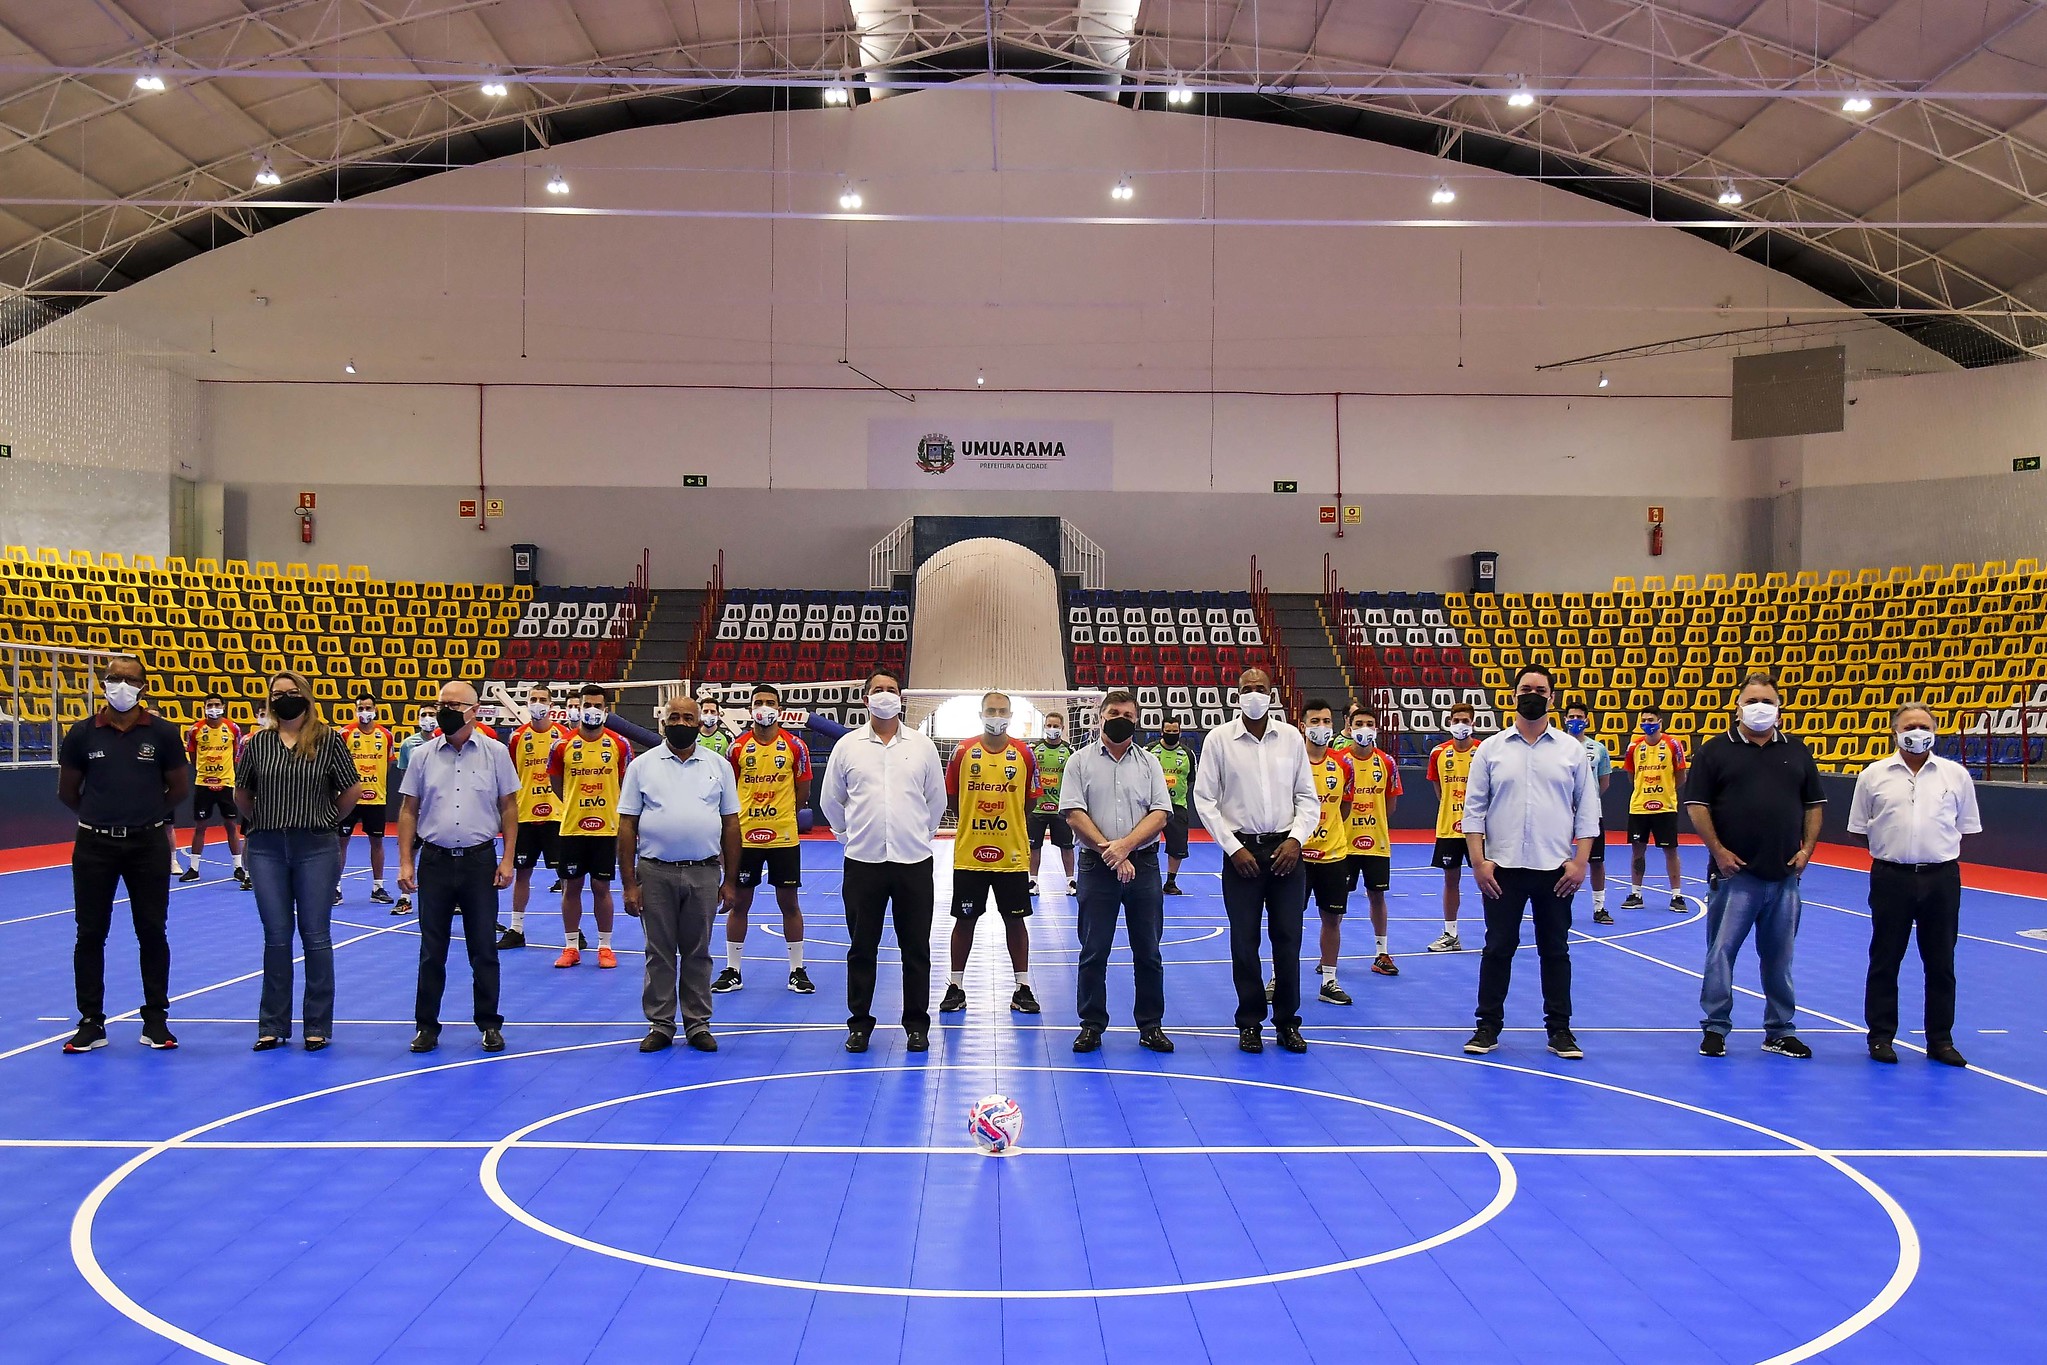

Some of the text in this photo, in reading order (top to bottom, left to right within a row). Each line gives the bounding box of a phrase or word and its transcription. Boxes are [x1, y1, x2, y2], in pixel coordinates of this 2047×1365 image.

[961, 441, 1067, 457] UMUARAMA
[979, 462, 1015, 470] PREFEITURA
[205, 763, 224, 772] LEVO
[524, 757, 548, 767] Batera
[570, 766, 605, 777] BateraX
[360, 773, 378, 782] LEVO
[744, 772, 779, 784] BateraX
[1444, 775, 1468, 783] Batera
[532, 786, 552, 795] LEVO
[967, 781, 1009, 793] BateraX
[1043, 787, 1058, 795] EVO
[1643, 785, 1664, 794] LEVO
[579, 796, 606, 807] LEVO
[977, 801, 1005, 812] Zaeli
[748, 804, 777, 817] LEVO
[580, 819, 601, 829] Astra
[972, 816, 1008, 831] LEVO
[1352, 815, 1377, 826] LEVO
[748, 831, 771, 841] Astra
[1312, 826, 1329, 838] VO
[975, 849, 998, 860] Astra
